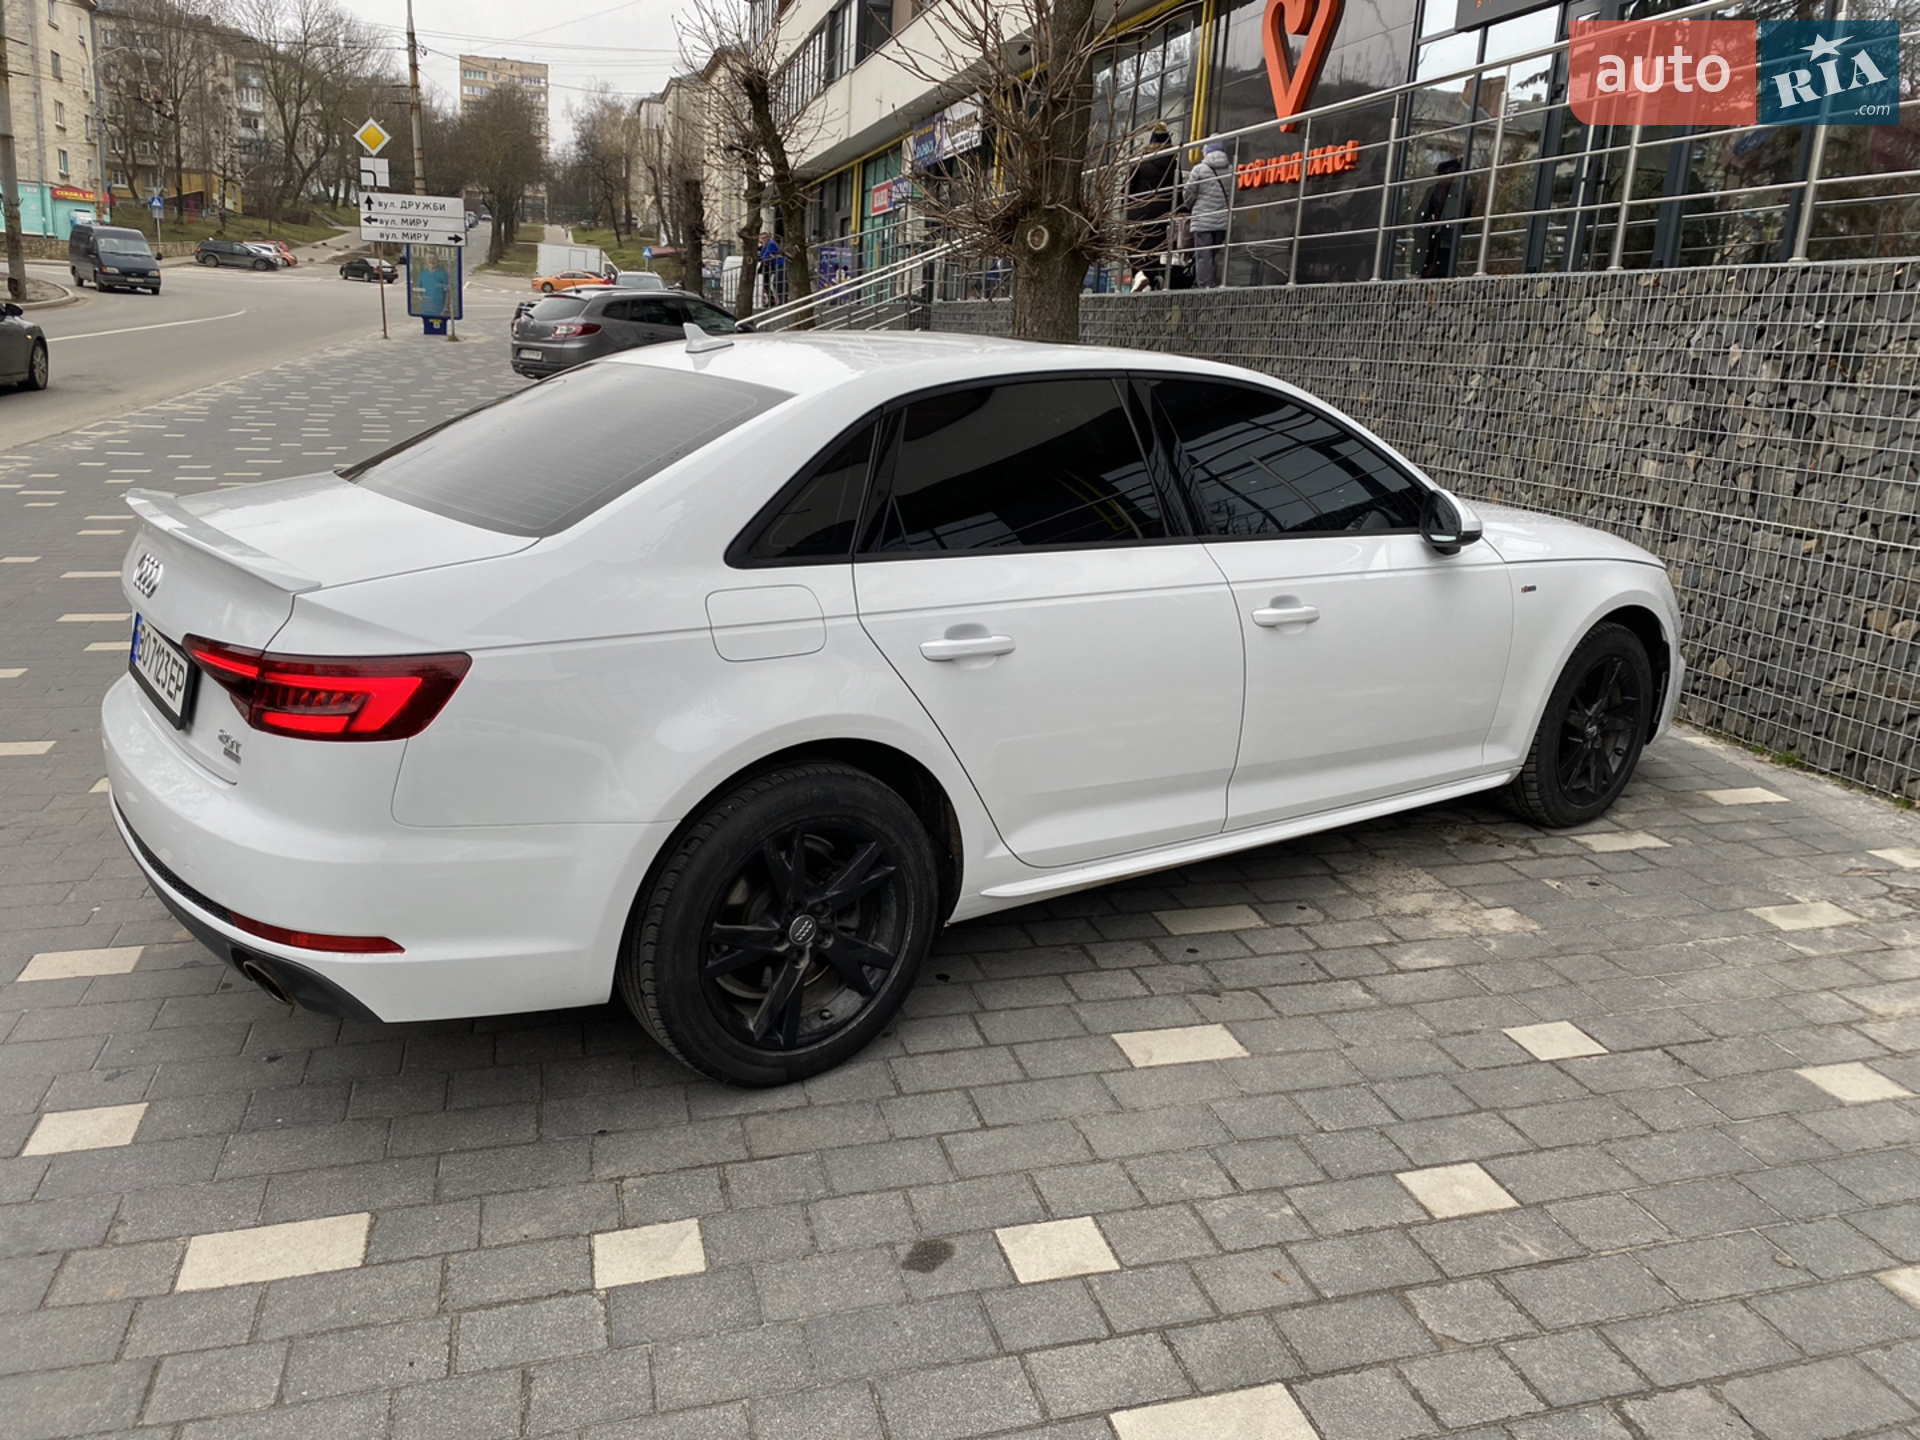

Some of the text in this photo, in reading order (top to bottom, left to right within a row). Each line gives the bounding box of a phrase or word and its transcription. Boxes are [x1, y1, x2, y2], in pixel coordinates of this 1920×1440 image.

[378, 201, 446, 212] вул. ДРУЖБИ
[379, 218, 429, 227] вул. МИРУ
[379, 231, 430, 241] вул. МИРУ
